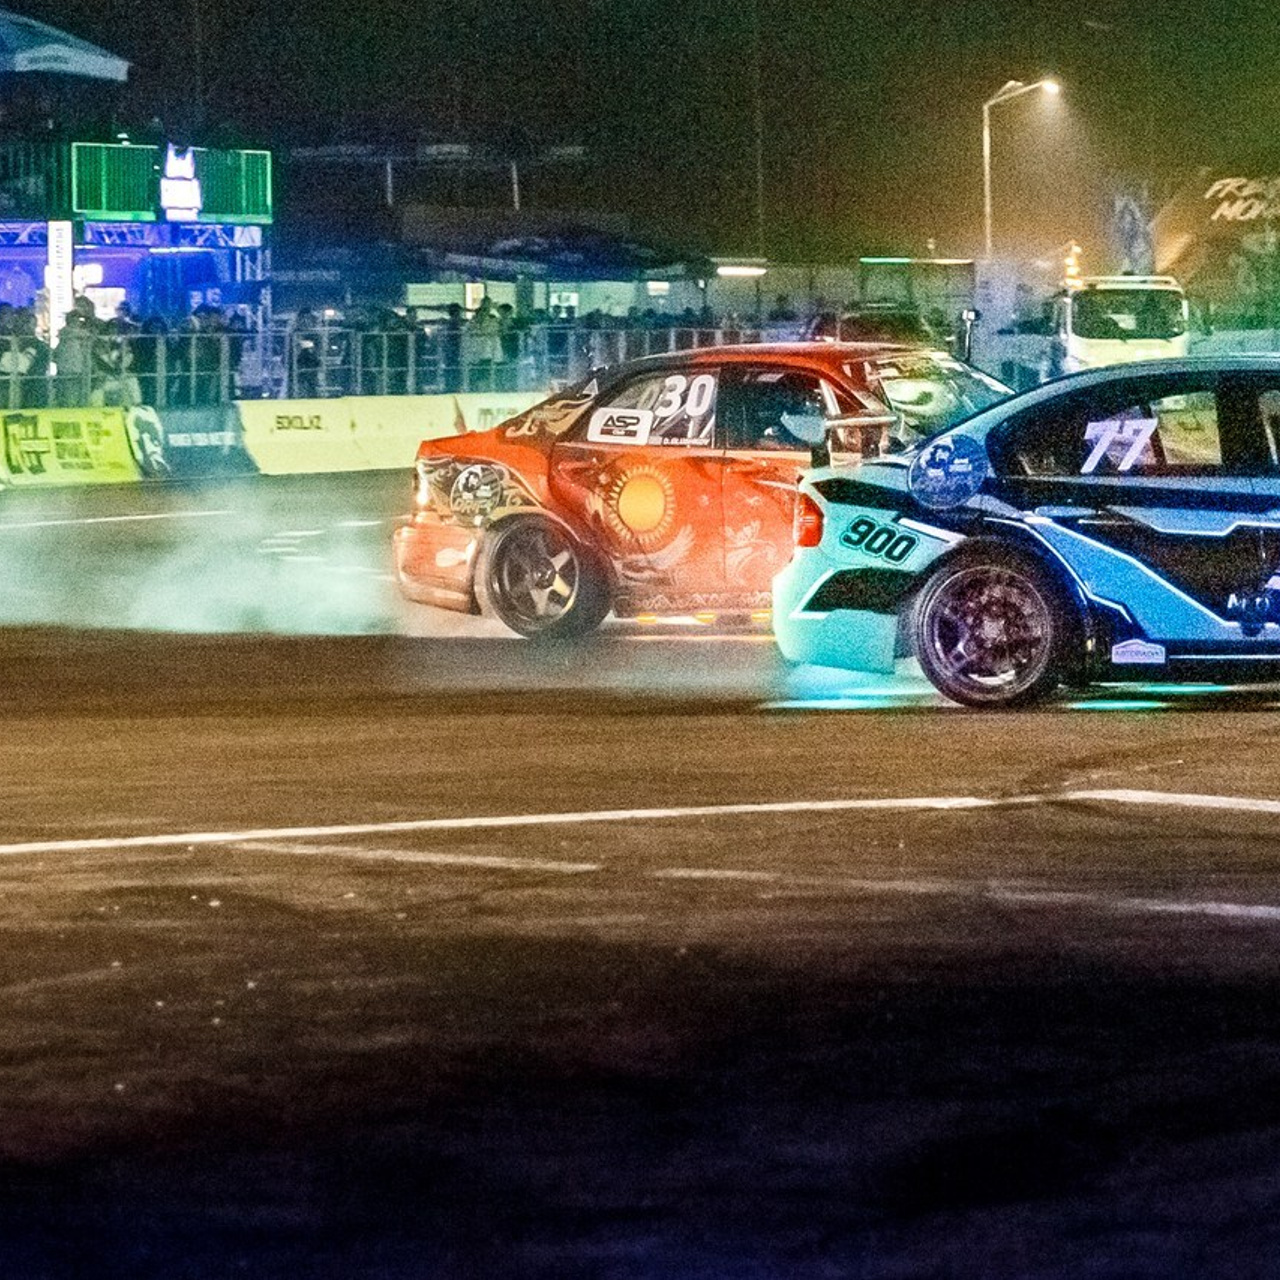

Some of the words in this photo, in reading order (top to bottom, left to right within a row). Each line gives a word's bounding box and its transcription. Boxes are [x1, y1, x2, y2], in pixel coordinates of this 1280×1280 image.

[654, 374, 716, 418] 30
[603, 415, 641, 428] ASP
[1080, 418, 1158, 473] 77
[841, 517, 918, 563] 900
